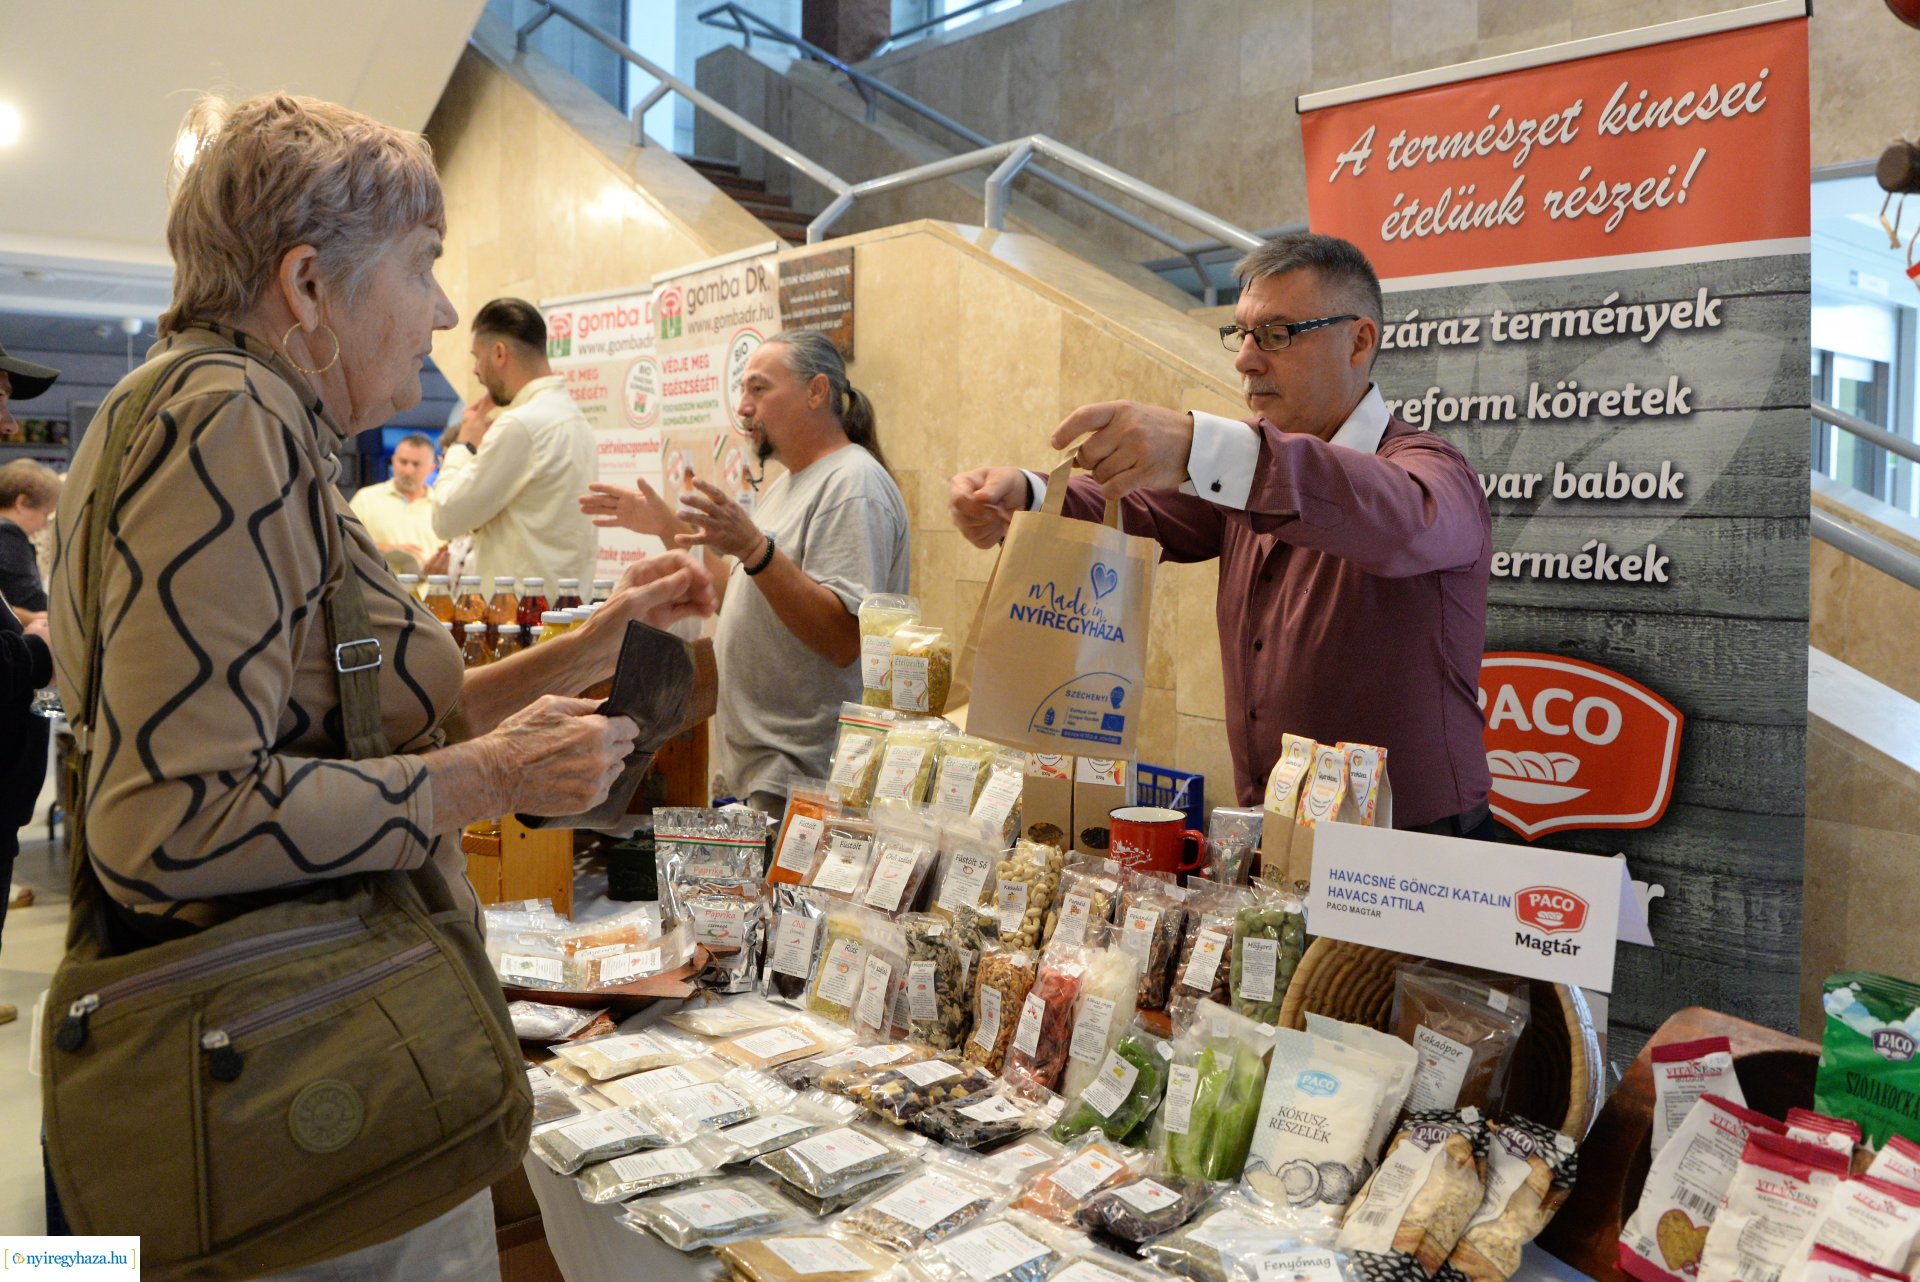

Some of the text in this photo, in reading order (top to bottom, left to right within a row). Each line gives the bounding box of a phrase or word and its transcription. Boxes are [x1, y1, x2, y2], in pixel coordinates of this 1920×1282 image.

[1329, 68, 1769, 182] A természet kincsei
[1381, 148, 1707, 241] ételünk részei!
[687, 274, 739, 315] gomba
[746, 264, 770, 294] DR.
[578, 306, 639, 339] gomba
[687, 302, 774, 334] www.gombadr.hu
[1490, 287, 1722, 343] termények
[1386, 375, 1692, 431] reform köretek
[1553, 460, 1684, 499] babok
[1490, 539, 1670, 583] ermékek
[1028, 581, 1091, 616] Made
[1010, 603, 1125, 643] NYÍREGYHÁZA
[1065, 689, 1108, 702] SZÉCHENYI
[840, 840, 862, 850] Füstölt
[693, 866, 724, 875] Paprika
[956, 853, 987, 870] Füstölt Só
[1328, 886, 1425, 913] HAVACS ATTILA
[1329, 868, 1512, 908] HAVACSNÉ GÖNCZI KATALIN
[705, 910, 736, 919] Paprika
[1326, 901, 1381, 918] PACO MAGTÁR
[1529, 893, 1575, 912] PACO
[844, 944, 859, 954] Rizs
[1248, 942, 1273, 951] Mogyoró
[1515, 932, 1581, 957] Magtár
[1419, 1031, 1463, 1057] Kakaópor
[1879, 1033, 1912, 1053] PACO
[1302, 1075, 1335, 1090] PACO
[1278, 1105, 1330, 1128] KÓKUSZ-
[1269, 1117, 1332, 1144] RESZELÉK
[1417, 1127, 1447, 1142] PACO
[1503, 1127, 1532, 1152] PACO
[1264, 1256, 1331, 1272] Fenyőmag
